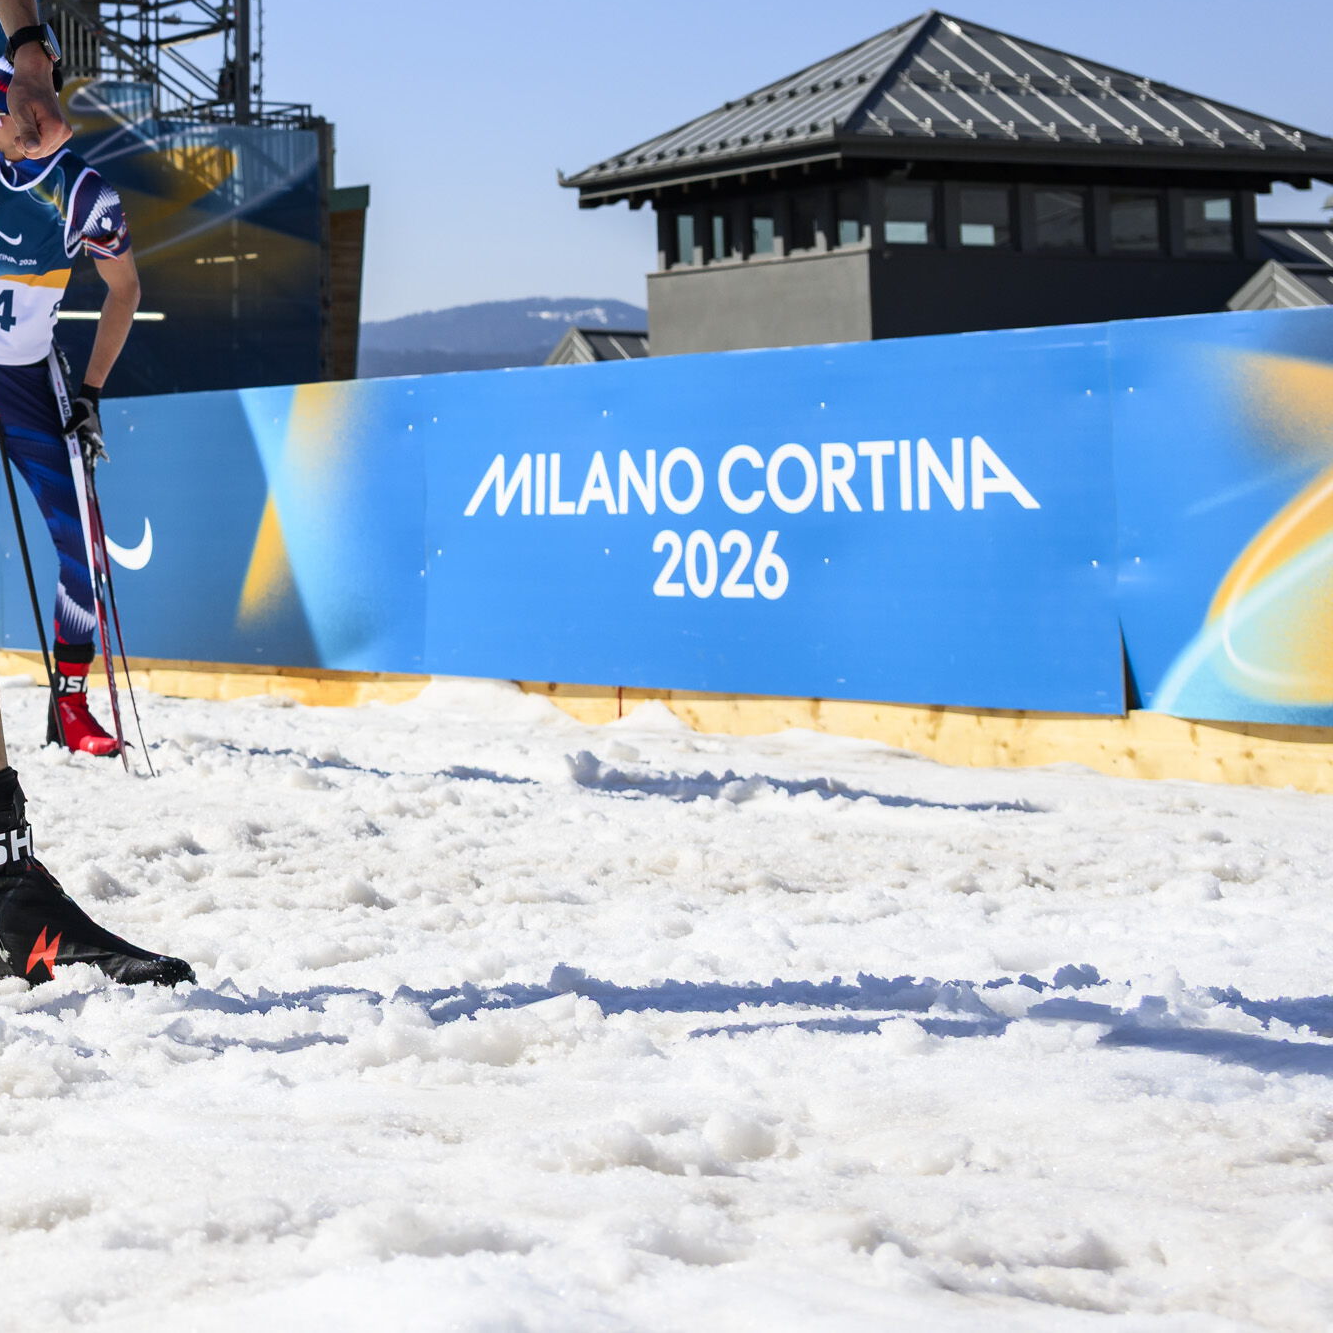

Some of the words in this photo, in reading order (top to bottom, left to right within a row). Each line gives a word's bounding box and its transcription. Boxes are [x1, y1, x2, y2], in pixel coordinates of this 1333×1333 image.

[18, 258, 38, 266] 2026
[463, 452, 705, 516] MILANO
[717, 435, 1041, 515] CORTINA
[652, 529, 790, 601] 2026
